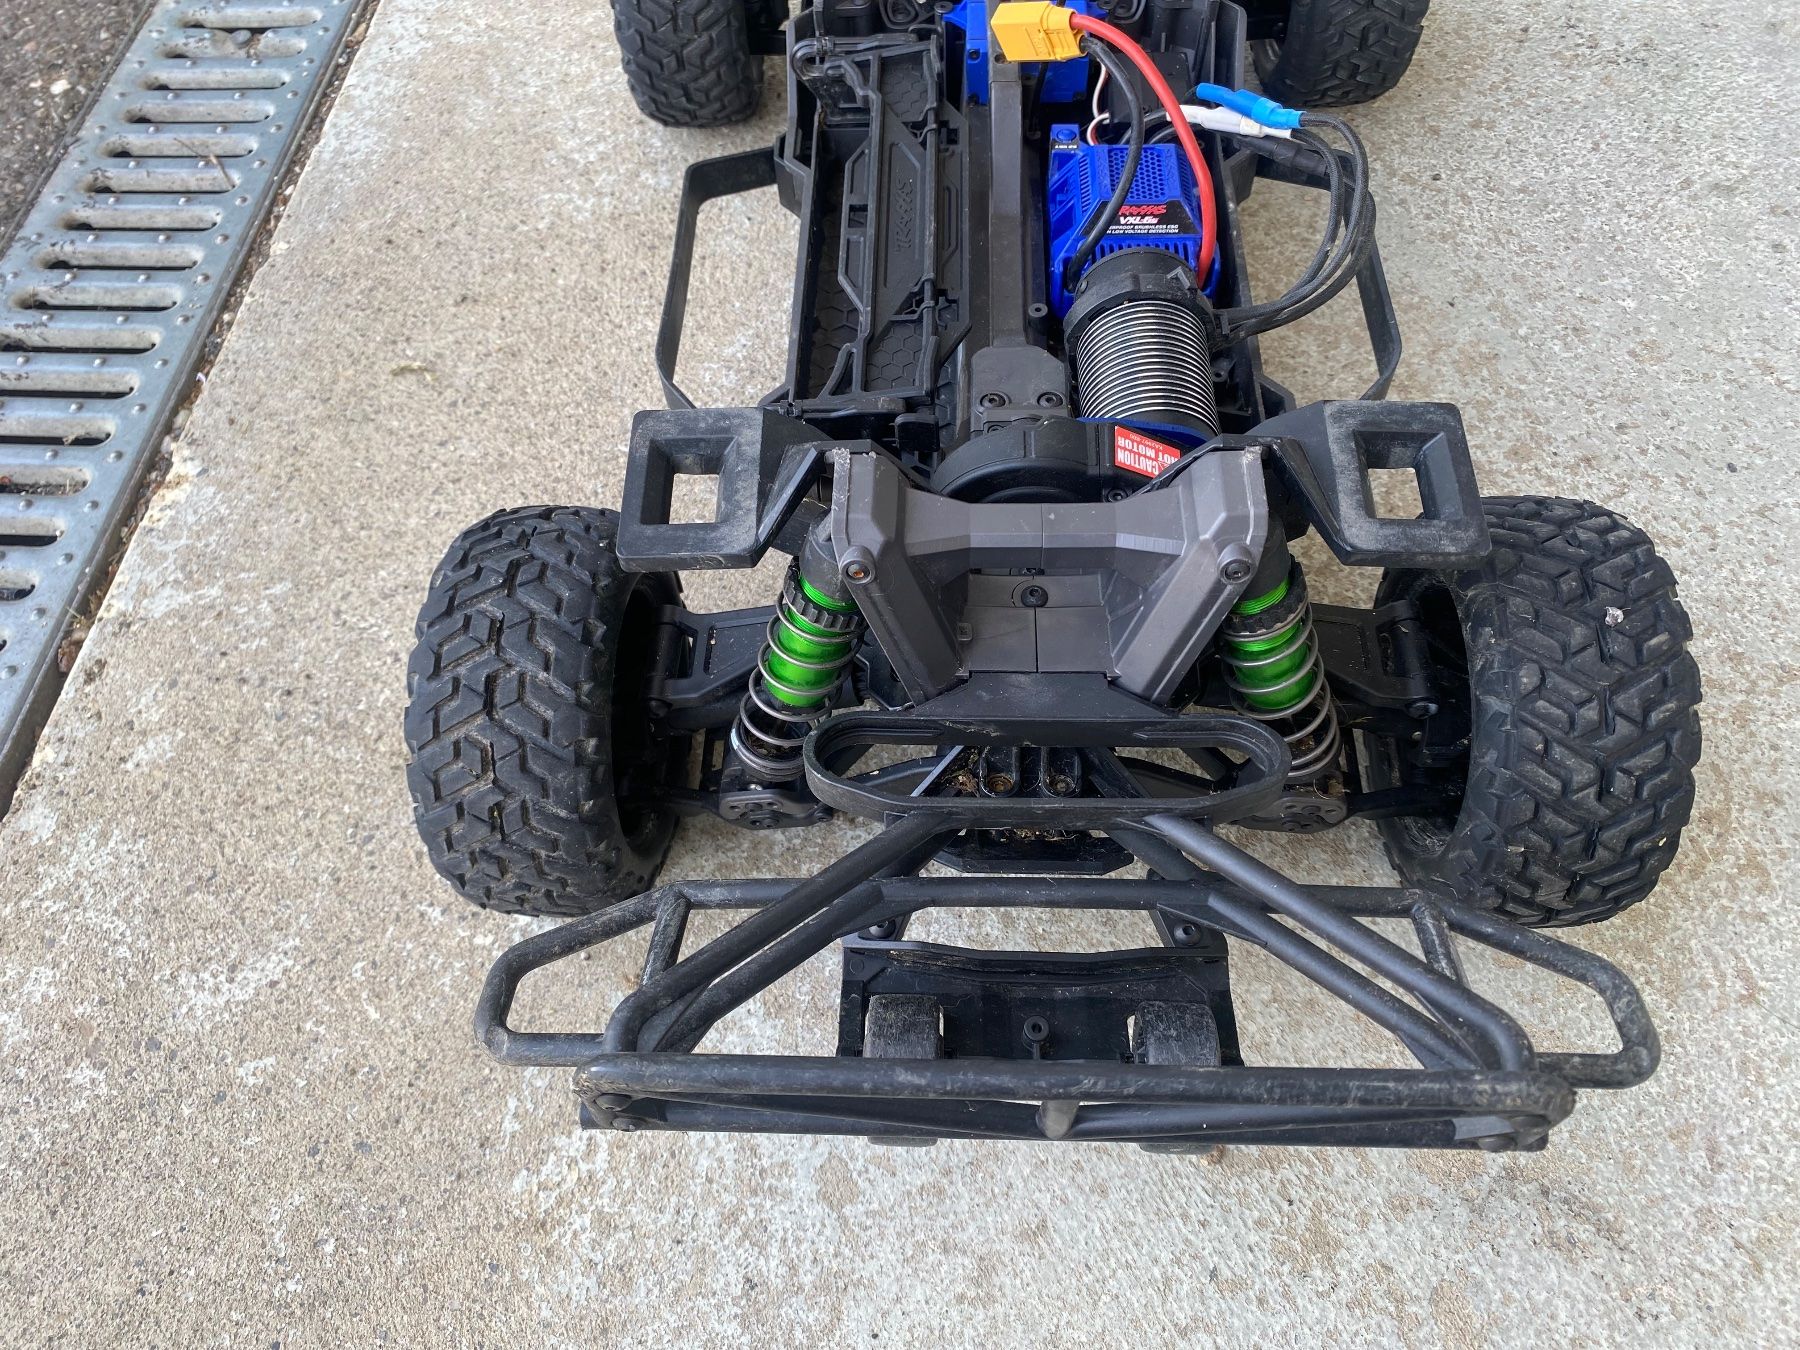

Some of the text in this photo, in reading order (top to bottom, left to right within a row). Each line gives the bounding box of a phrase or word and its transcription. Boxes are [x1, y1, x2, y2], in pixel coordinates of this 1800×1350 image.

[1118, 205, 1167, 216] RAXXAS
[1117, 436, 1156, 459] MOTOR
[1117, 447, 1159, 475] CAUTION
